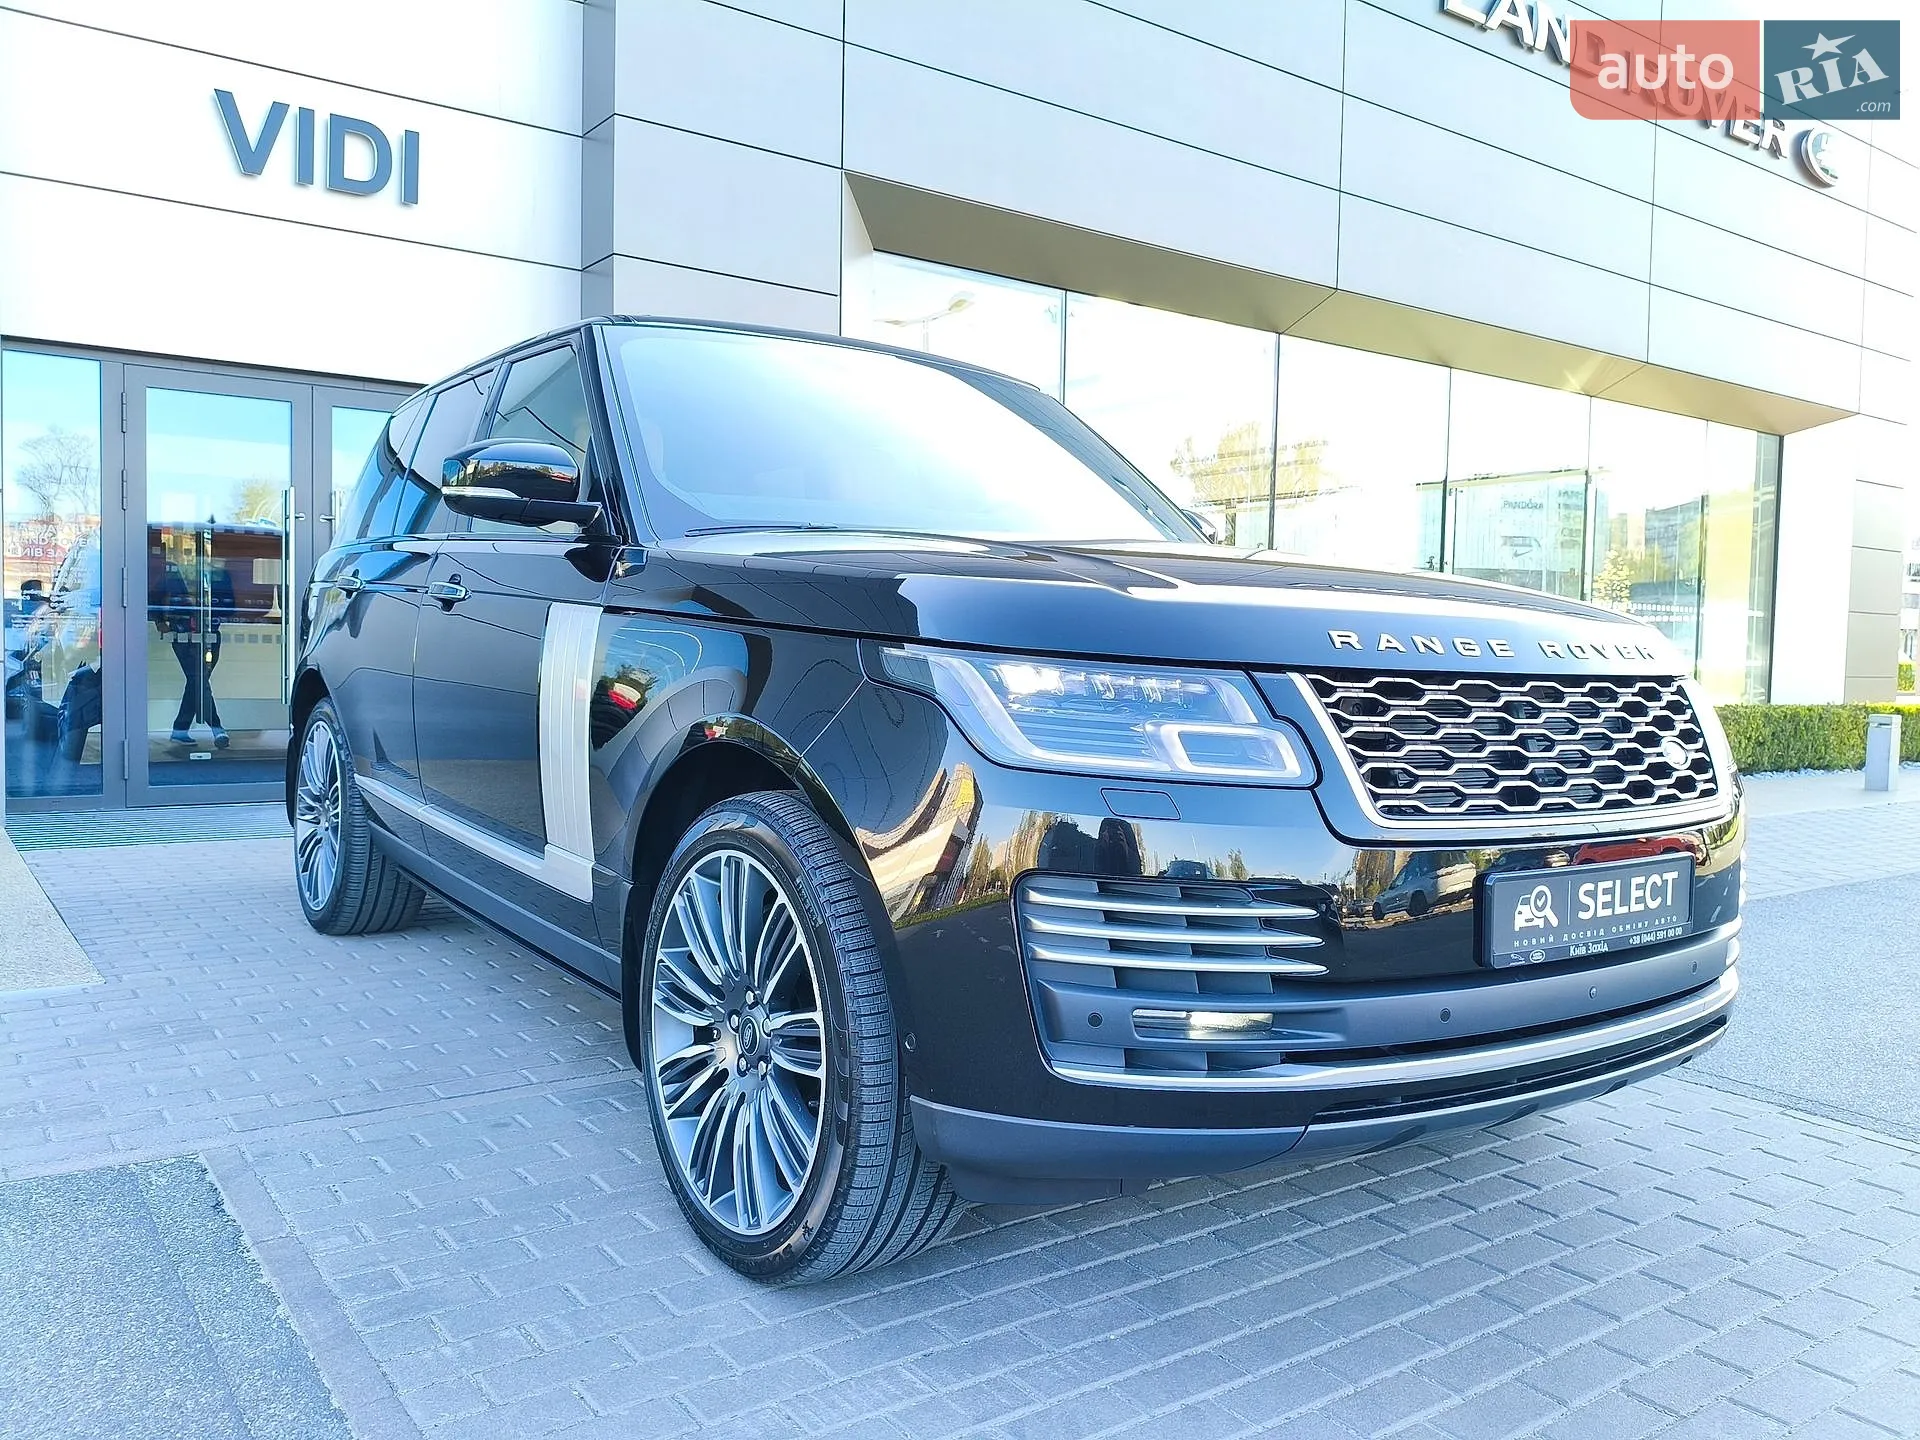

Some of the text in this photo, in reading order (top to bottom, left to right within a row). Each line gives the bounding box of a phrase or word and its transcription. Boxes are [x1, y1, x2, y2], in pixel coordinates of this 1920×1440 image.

[1625, 50, 1788, 159] ROVER
[213, 87, 420, 206] VIDI
[1327, 630, 1657, 660] RANGE ROVER
[1577, 871, 1679, 920] SELECT
[1514, 915, 1677, 948] НОВИЙ ДОСВІД ОБМІНУ АВТО
[1629, 926, 1683, 945] +38 (044) 591 00 00
[1569, 943, 1587, 957] Київ
